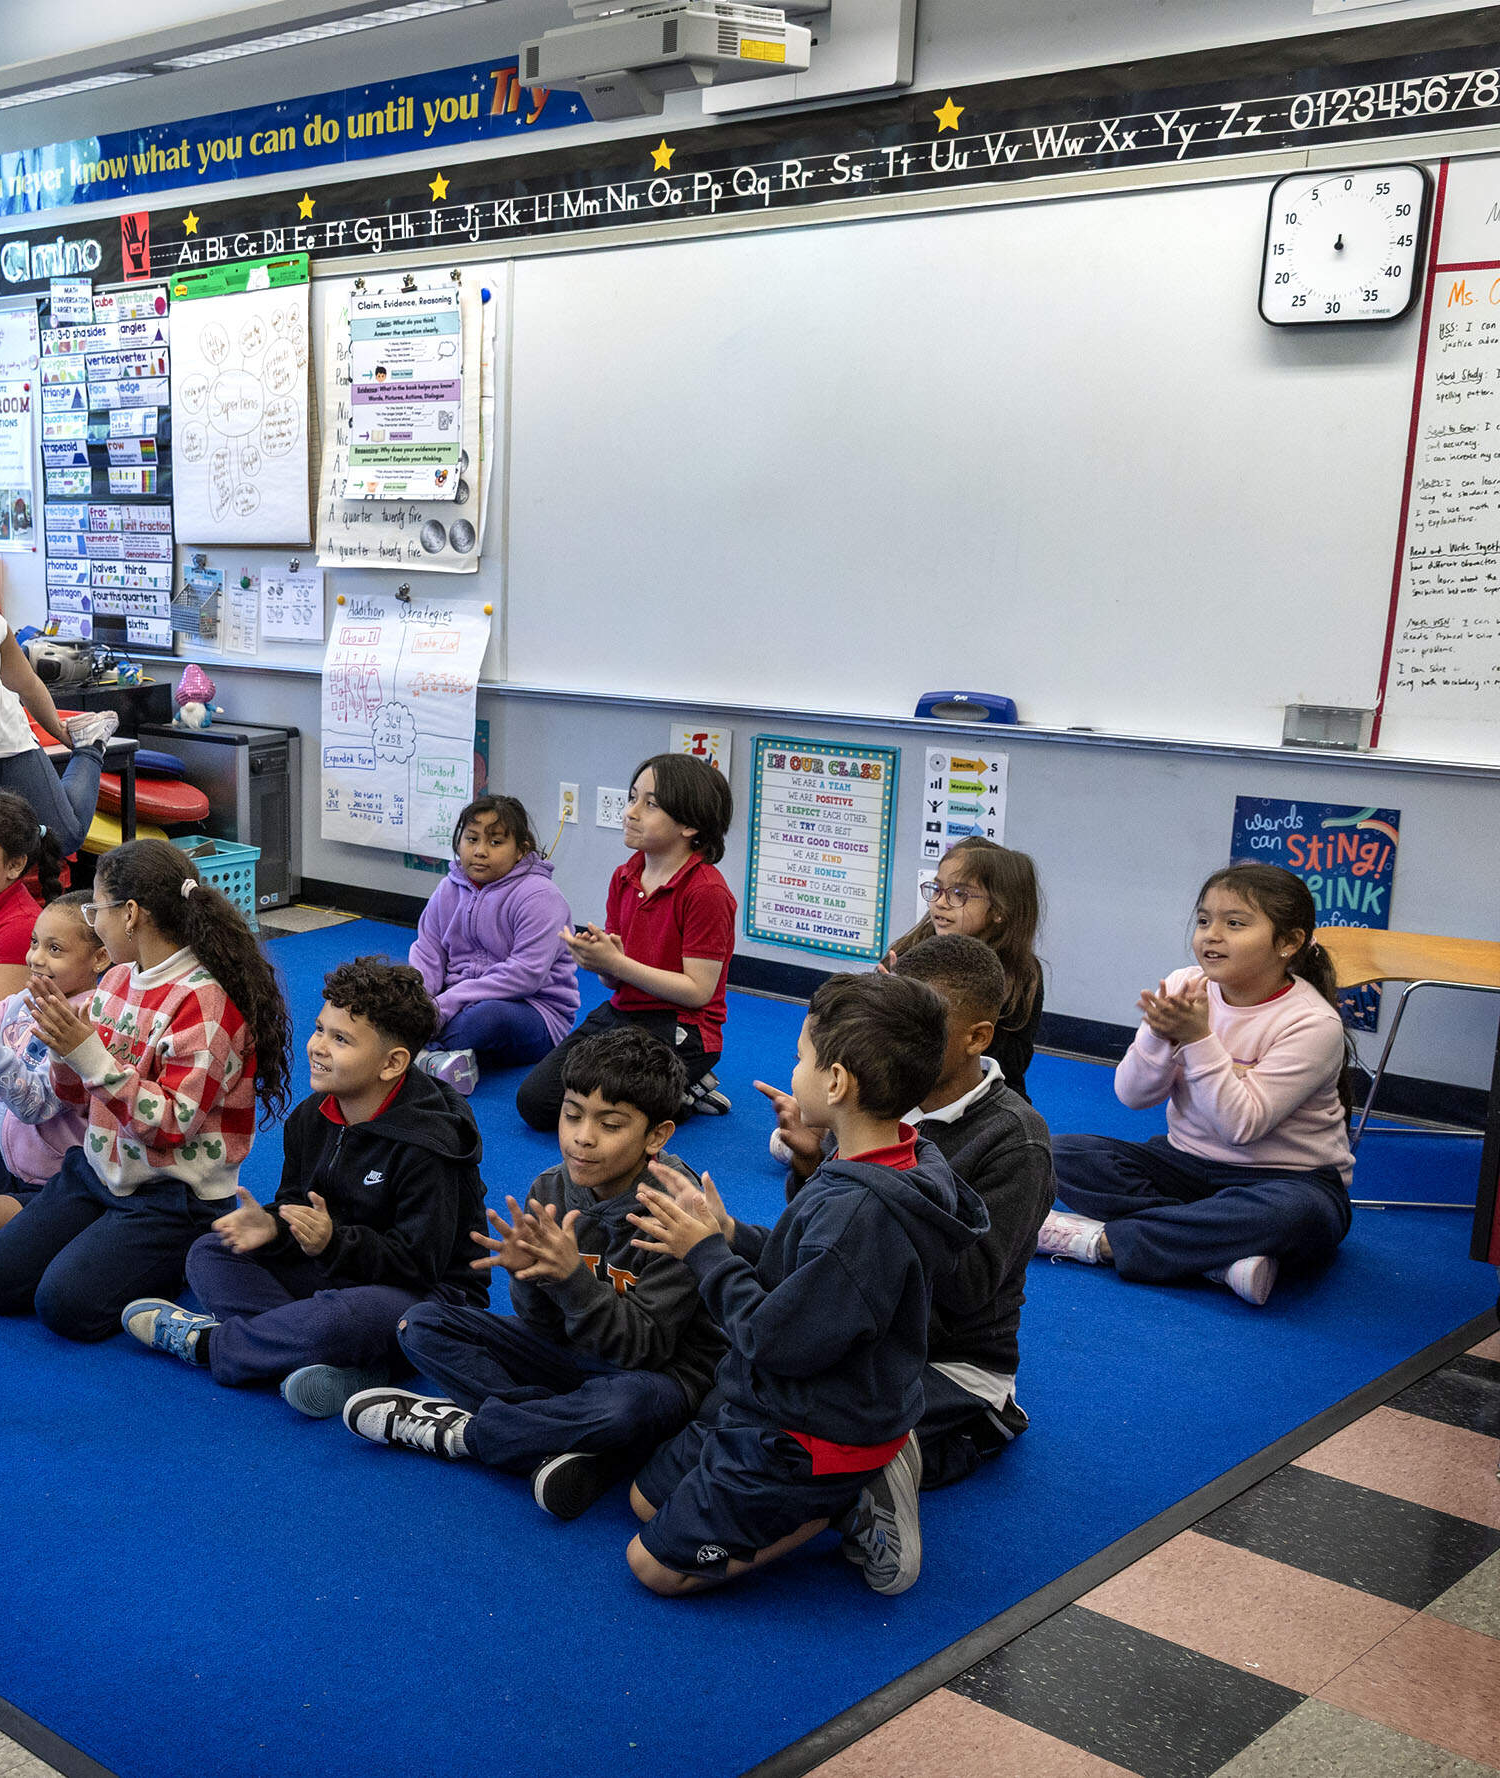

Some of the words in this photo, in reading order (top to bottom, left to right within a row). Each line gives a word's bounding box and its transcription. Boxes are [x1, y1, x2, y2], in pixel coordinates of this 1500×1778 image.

[9, 167, 65, 196] never
[70, 156, 128, 187] know
[133, 139, 191, 175] what
[198, 136, 242, 174] you
[249, 126, 296, 156] can
[303, 115, 340, 147] do
[347, 96, 414, 139] until
[423, 93, 479, 137] you
[489, 67, 550, 125] Try
[178, 242, 200, 265] Aa
[206, 237, 228, 260] Bb
[234, 233, 257, 257] Cc
[264, 229, 285, 253] Dd
[295, 226, 315, 250] Ee
[326, 221, 347, 247] Ff
[354, 218, 382, 253] Gg
[389, 213, 414, 240] Hh
[429, 209, 442, 235] Ii
[459, 205, 480, 242] Jj
[495, 200, 520, 226] Kk
[535, 193, 552, 222] Ll
[564, 190, 599, 218] Mm
[607, 184, 638, 213] Nn
[648, 178, 682, 207] Oo
[694, 173, 722, 213] Pp
[732, 167, 770, 207] Qq
[782, 159, 813, 190] Rr
[830, 154, 864, 184] Ss
[882, 147, 911, 178] Tt
[931, 140, 968, 172] Uu
[985, 134, 1019, 165] Vv
[1033, 126, 1084, 159] Ww
[1096, 118, 1137, 153] Xx
[1154, 111, 1197, 160] Yy
[1217, 103, 1261, 140] Zz
[1344, 179, 1352, 190] 0
[1376, 183, 1390, 195] 55
[1312, 189, 1319, 200] 5
[1395, 204, 1411, 217] 50
[1285, 213, 1297, 225] 10
[1397, 235, 1413, 248] 45
[1273, 244, 1285, 256] 15
[1385, 265, 1401, 277] 40
[1275, 273, 1290, 284] 20
[1363, 290, 1378, 302] 35
[1448, 280, 1478, 307] Ms.
[95, 297, 113, 307] cube
[358, 301, 381, 310] Claim,
[384, 299, 417, 308] Evidence,
[419, 296, 452, 305] Reasoning
[1291, 295, 1307, 307] 25
[1325, 302, 1340, 314] 30
[87, 327, 106, 337] sides
[120, 323, 146, 335] angles
[87, 355, 120, 365] vertices
[120, 353, 146, 362] vertex
[43, 386, 71, 398] triangle
[44, 442, 77, 454] trapezoid
[329, 503, 334, 522] A
[342, 505, 372, 530] quarter
[382, 506, 404, 529] twenty
[93, 563, 116, 573] halves
[125, 564, 146, 575] thirds
[93, 591, 121, 601] fourths
[122, 592, 157, 603] quarters
[348, 599, 385, 618] Addition
[399, 602, 452, 627] Strategies
[128, 620, 149, 630] sixths
[767, 753, 786, 770] IN
[790, 756, 824, 774] OUR
[828, 760, 881, 780] CLASS
[991, 763, 998, 772] S
[792, 777, 802, 786] WE
[802, 778, 817, 788] ARE
[820, 781, 825, 789] A
[828, 781, 851, 791] TEAM
[989, 785, 998, 794] M
[788, 791, 799, 800] WE
[799, 793, 813, 802] ARE
[816, 794, 853, 807] POSITIVE
[774, 804, 784, 813] WE
[786, 805, 821, 817] RESPECT
[823, 810, 842, 820] EACH
[844, 812, 868, 824] OTHER
[988, 807, 996, 816] A
[1245, 804, 1304, 831] words
[787, 820, 798, 829] WE
[800, 822, 816, 831] TRY
[818, 824, 833, 834] OUR
[835, 826, 852, 837] BEST
[987, 828, 995, 837] R
[770, 832, 779, 840] WE
[782, 833, 804, 844] MAKE
[807, 837, 830, 848] GOOD
[833, 840, 869, 853] CHOICES
[1250, 835, 1282, 850] can
[821, 854, 842, 864] KIND
[814, 867, 848, 879] HONEST
[767, 874, 777, 883] WE
[779, 876, 807, 888] LISTEN
[810, 881, 820, 890] TO
[822, 882, 841, 893] EACH
[843, 886, 868, 897] OTHER
[784, 891, 794, 900] WE
[797, 893, 821, 904] WORK
[823, 897, 847, 909] HARD
[762, 901, 772, 911] WE
[774, 904, 822, 919] ENCOURAGE
[824, 912, 843, 923] EACH
[844, 916, 869, 927] OTHER
[767, 916, 778, 926] WE
[779, 918, 793, 928] ARE
[795, 922, 810, 931] ALL
[813, 925, 860, 940] IMPORTANT
